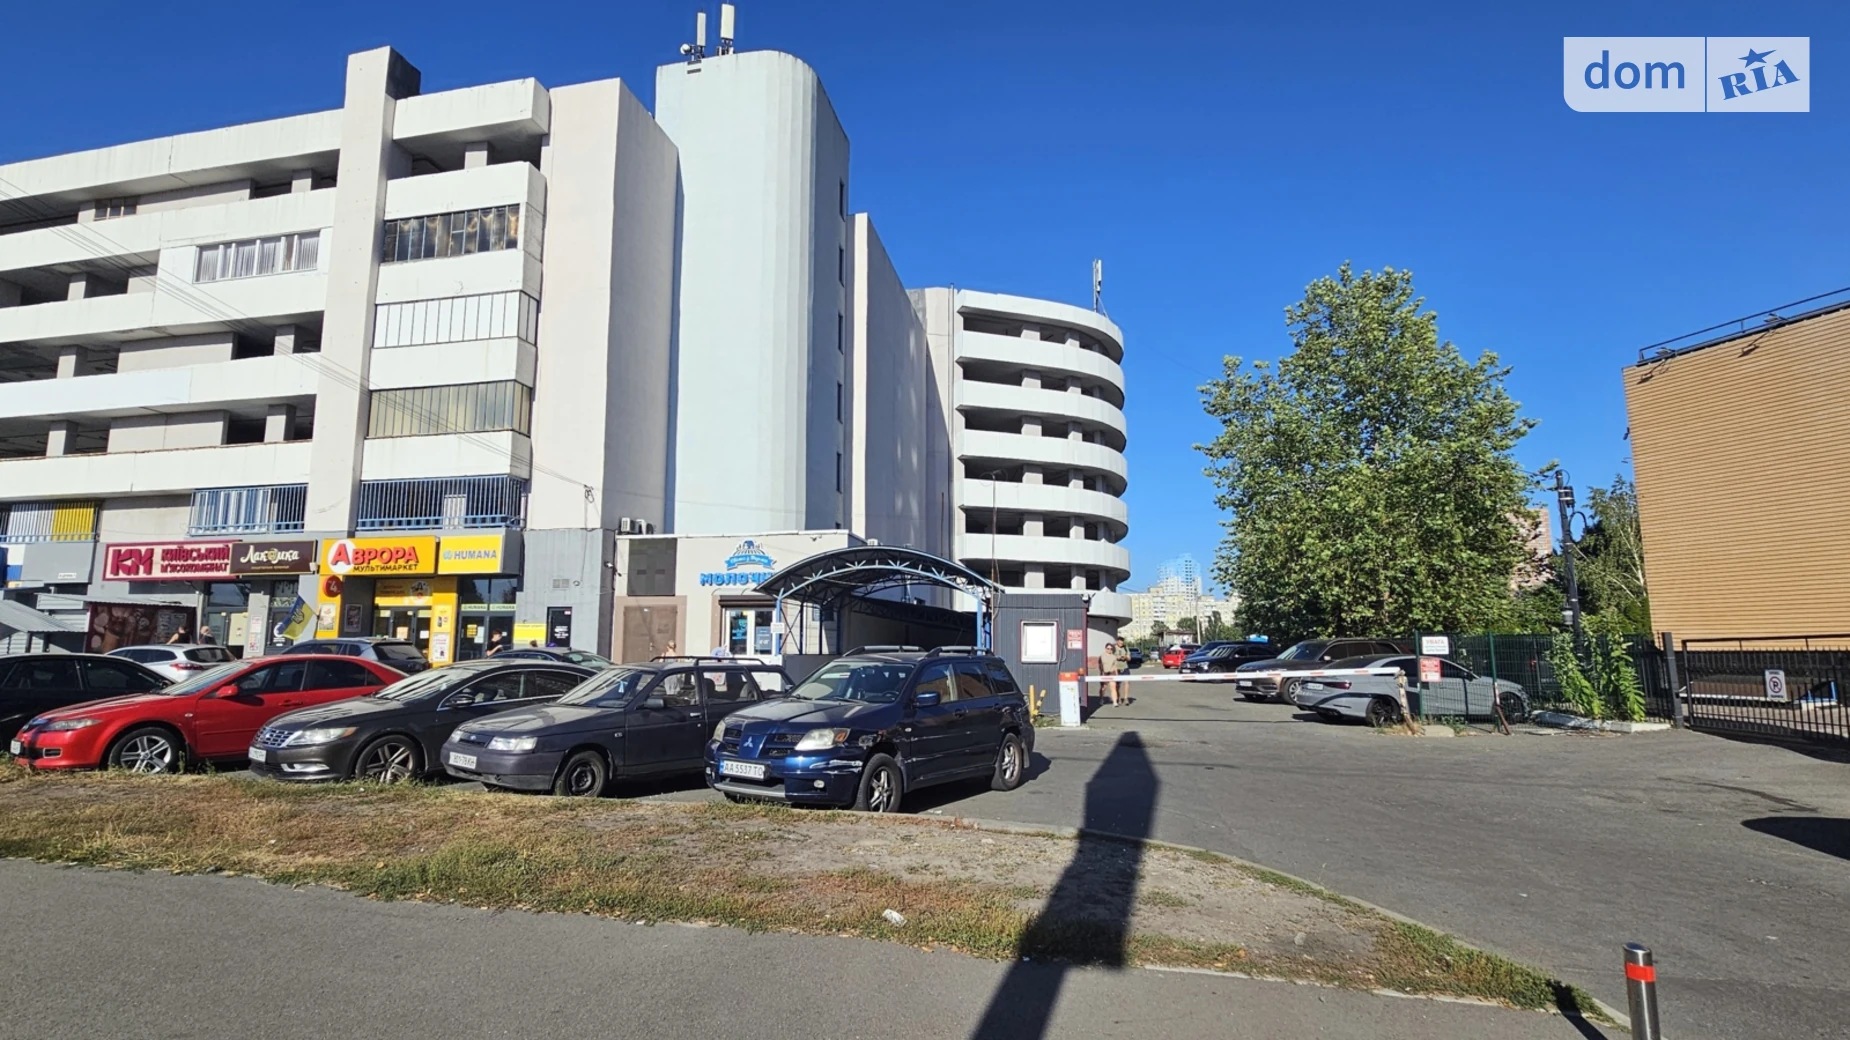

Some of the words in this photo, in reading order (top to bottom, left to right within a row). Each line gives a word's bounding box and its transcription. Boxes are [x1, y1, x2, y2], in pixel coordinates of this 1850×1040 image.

[161, 545, 230, 562] КИЇВСЬКИЙ
[330, 543, 419, 566] АВРОРА
[454, 549, 497, 560] HUMANA
[353, 563, 418, 572] МУЛЬТИМАРКЕТ
